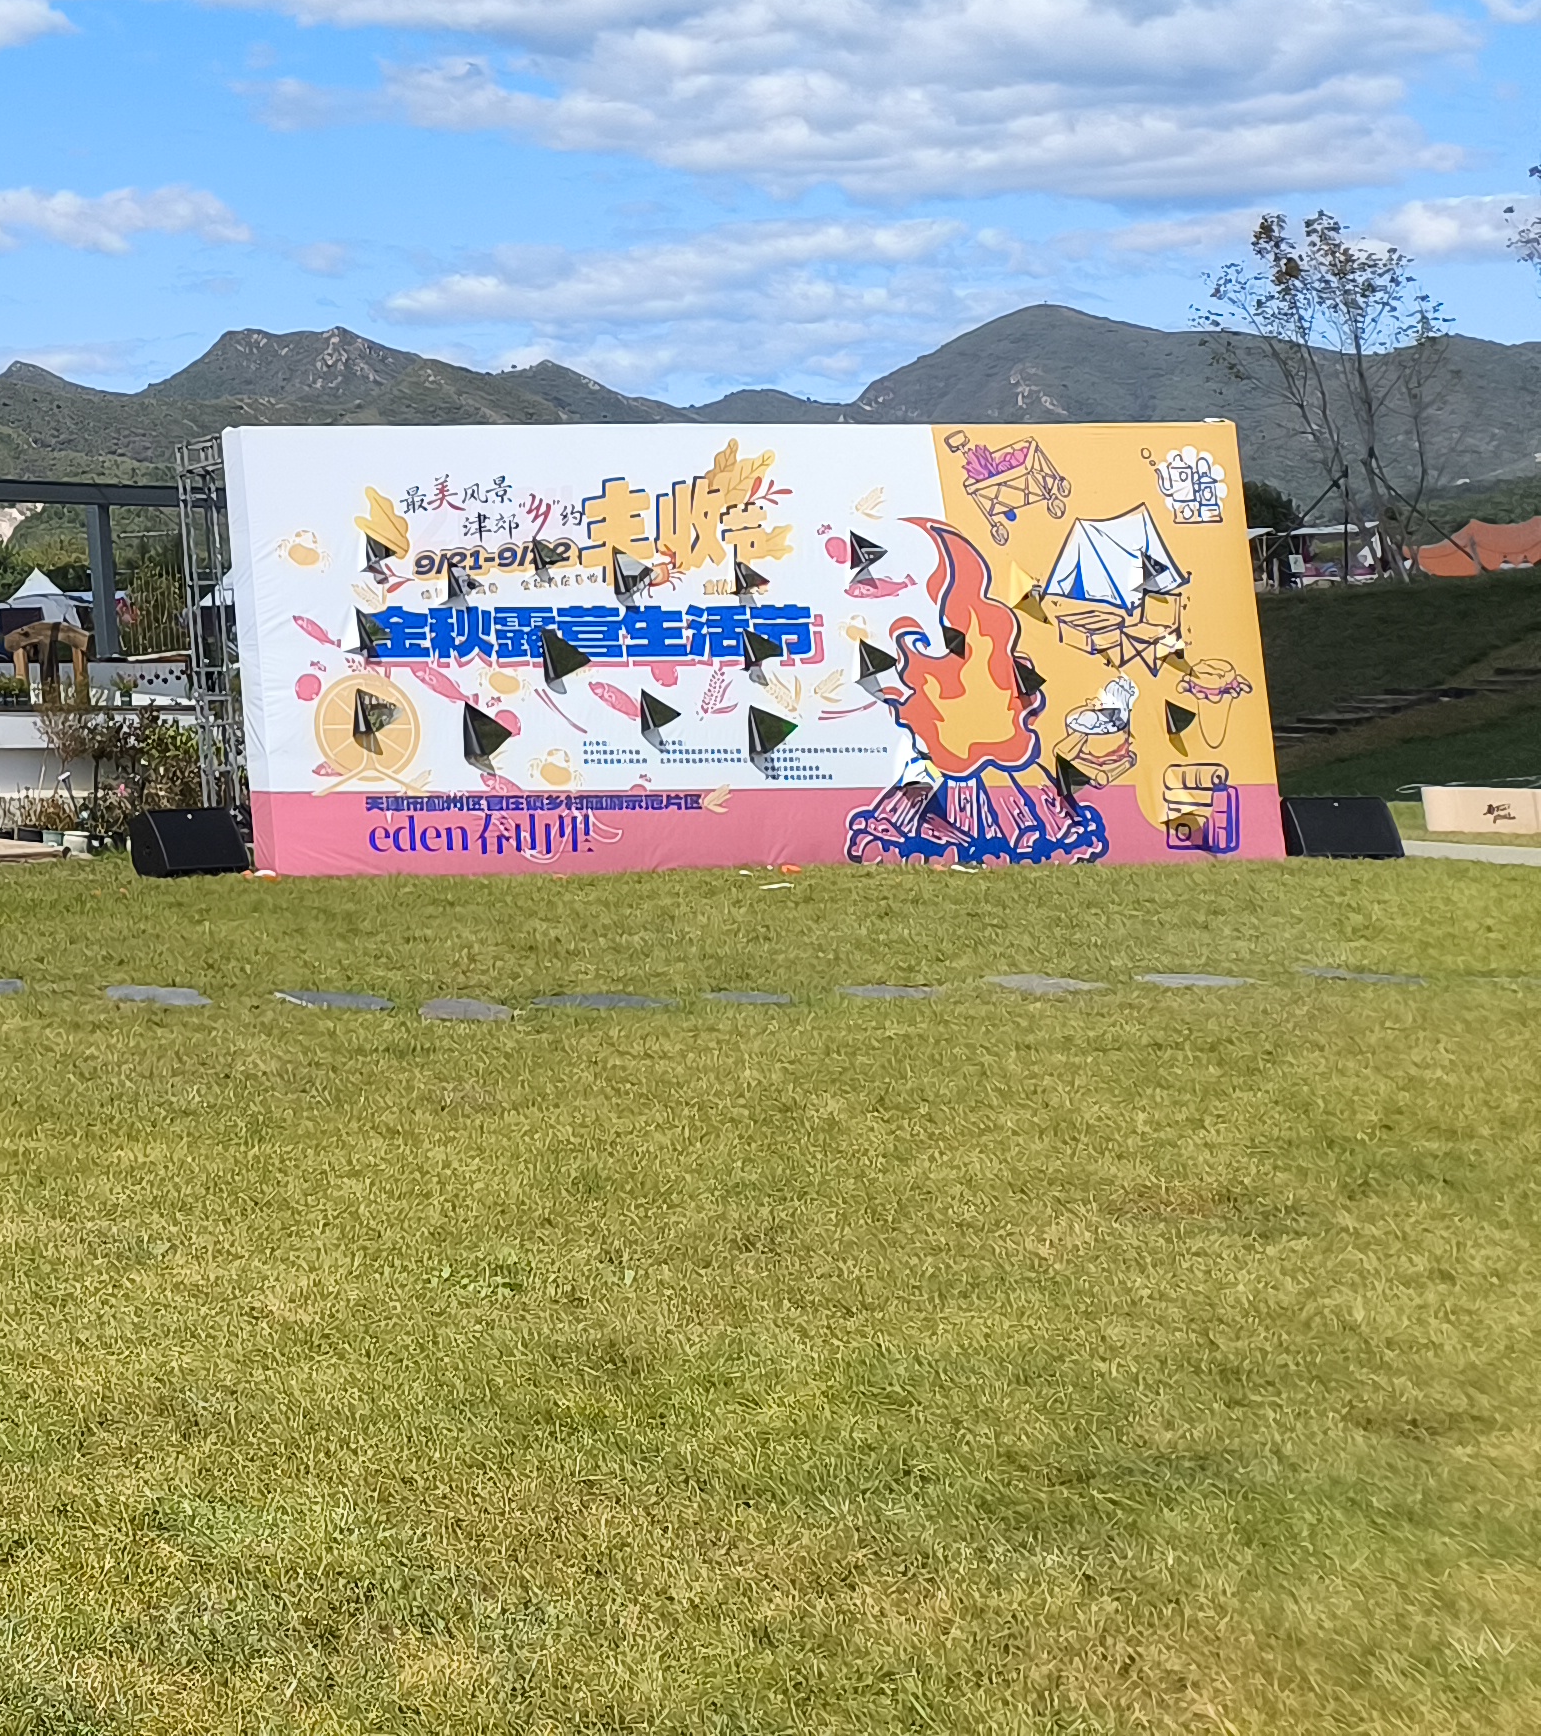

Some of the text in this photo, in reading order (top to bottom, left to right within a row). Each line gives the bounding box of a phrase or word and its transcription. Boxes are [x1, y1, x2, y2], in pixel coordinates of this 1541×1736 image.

[399, 474, 513, 515] 最美风景
[414, 540, 572, 576] 9/21-9/2
[369, 604, 814, 660] 金秋露营生活节
[368, 814, 470, 853] eden
